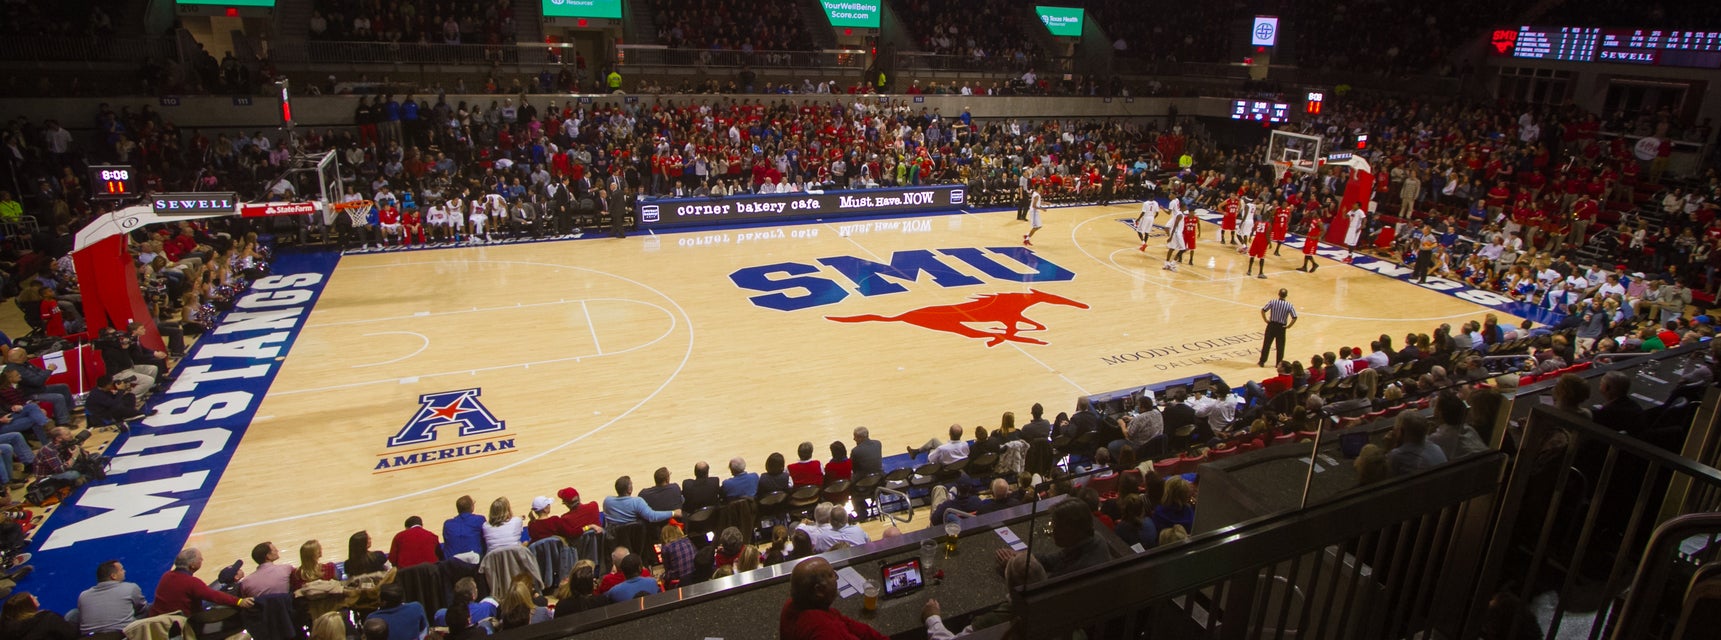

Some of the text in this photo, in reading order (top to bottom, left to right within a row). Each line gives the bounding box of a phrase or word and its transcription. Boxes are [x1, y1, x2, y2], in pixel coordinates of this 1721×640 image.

[824, 2, 877, 12] YourWellBeing
[831, 10, 869, 19] Score.com
[1492, 30, 1518, 41] SMU
[1600, 51, 1653, 61] SEWELL
[102, 170, 129, 181] 8:08
[107, 181, 124, 194] 11
[156, 199, 232, 210] SEWELL
[677, 204, 731, 216] corner
[736, 202, 787, 214] bakery
[728, 246, 1077, 312] SMU
[1101, 331, 1265, 366] MOODY COLISEU
[38, 272, 324, 552] MUSTANGS
[373, 438, 516, 470] AMERICAN
